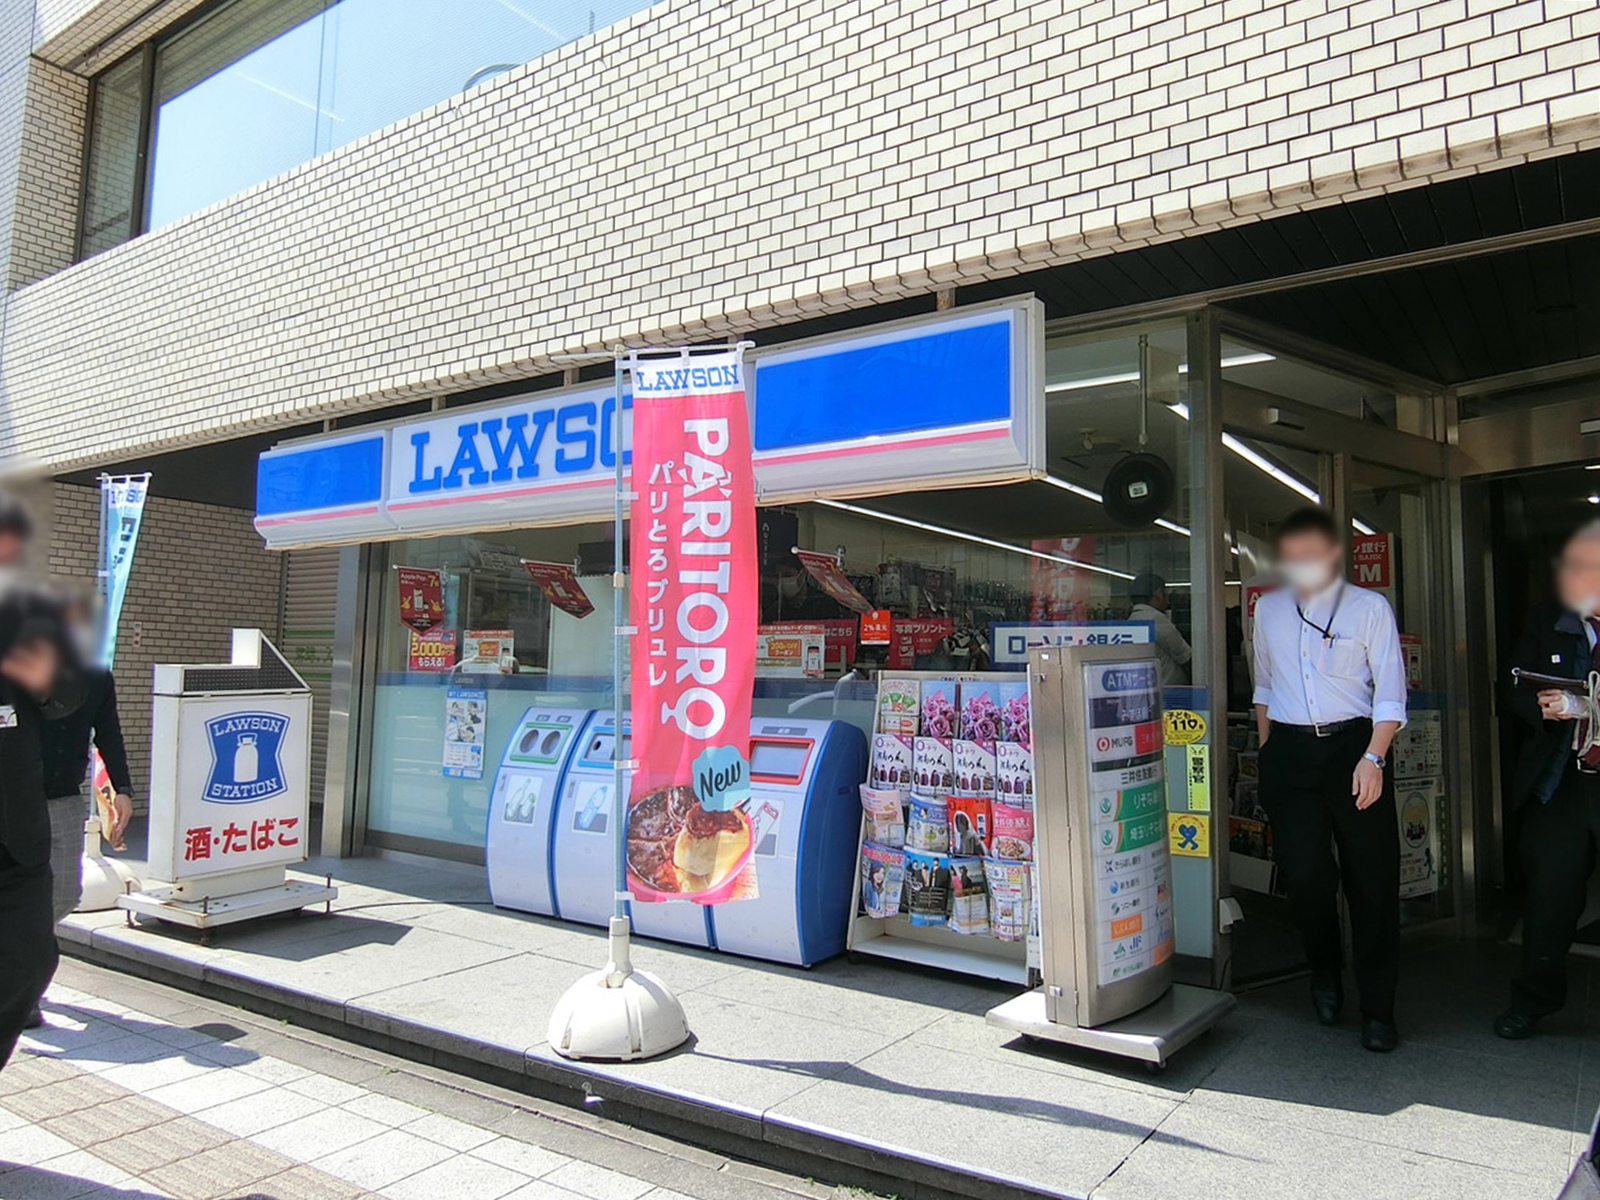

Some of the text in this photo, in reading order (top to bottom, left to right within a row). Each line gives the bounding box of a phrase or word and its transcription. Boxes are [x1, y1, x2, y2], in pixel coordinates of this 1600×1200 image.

[637, 364, 739, 391] LAWSON
[409, 393, 633, 493] LAWSO
[647, 460, 674, 686] パリとろブリュレ
[213, 717, 282, 737] LAWSON
[211, 777, 279, 798] STATION
[700, 760, 742, 802] New
[184, 817, 299, 861] 酒・たばこ
